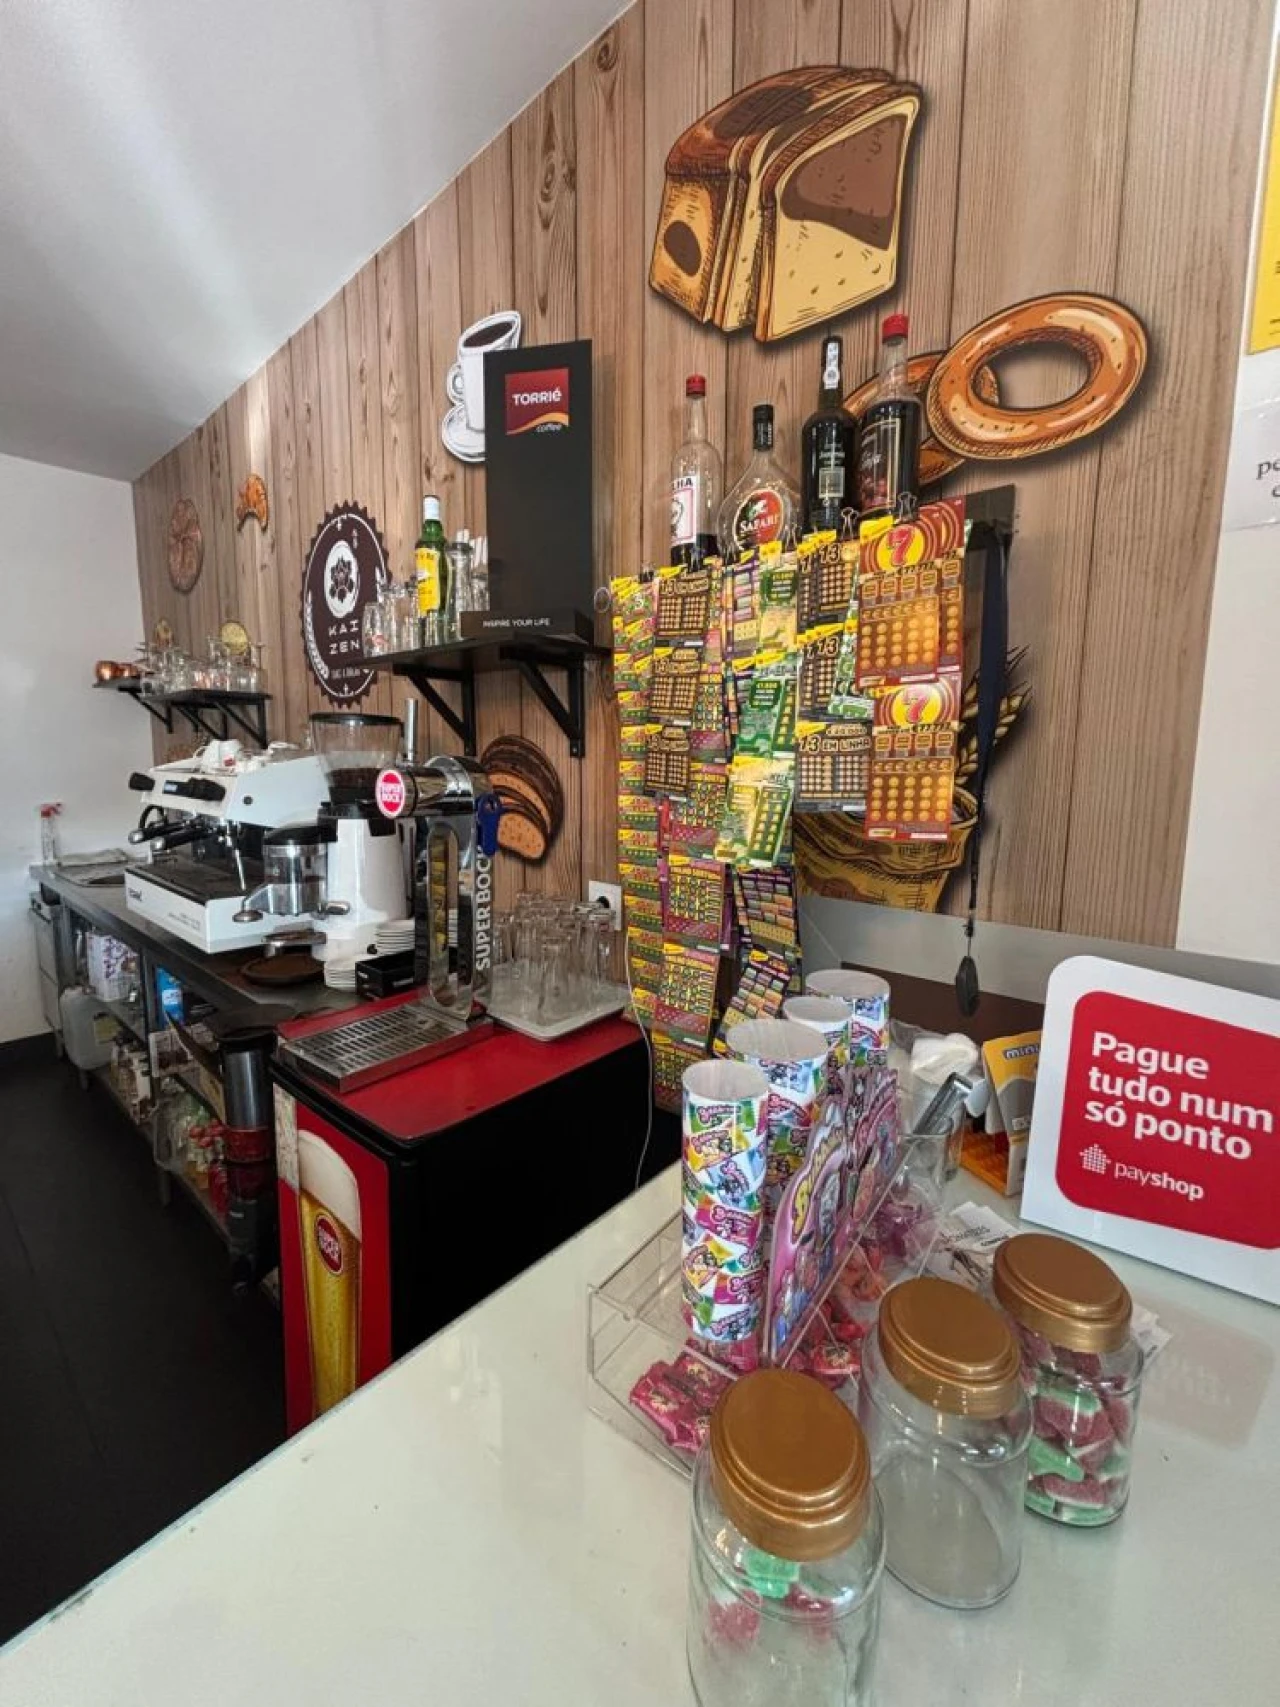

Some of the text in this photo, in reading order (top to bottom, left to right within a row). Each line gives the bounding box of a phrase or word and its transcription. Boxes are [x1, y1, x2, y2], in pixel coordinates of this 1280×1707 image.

[512, 618, 533, 628] YOUR
[533, 617, 550, 627] LIFE
[329, 639, 361, 656] ZEN
[475, 905, 491, 971] SUPER
[1091, 1031, 1210, 1080] Pague
[1087, 1066, 1275, 1133] tudo num
[1084, 1098, 1253, 1160] só ponto
[1113, 1159, 1205, 1202] payshop
